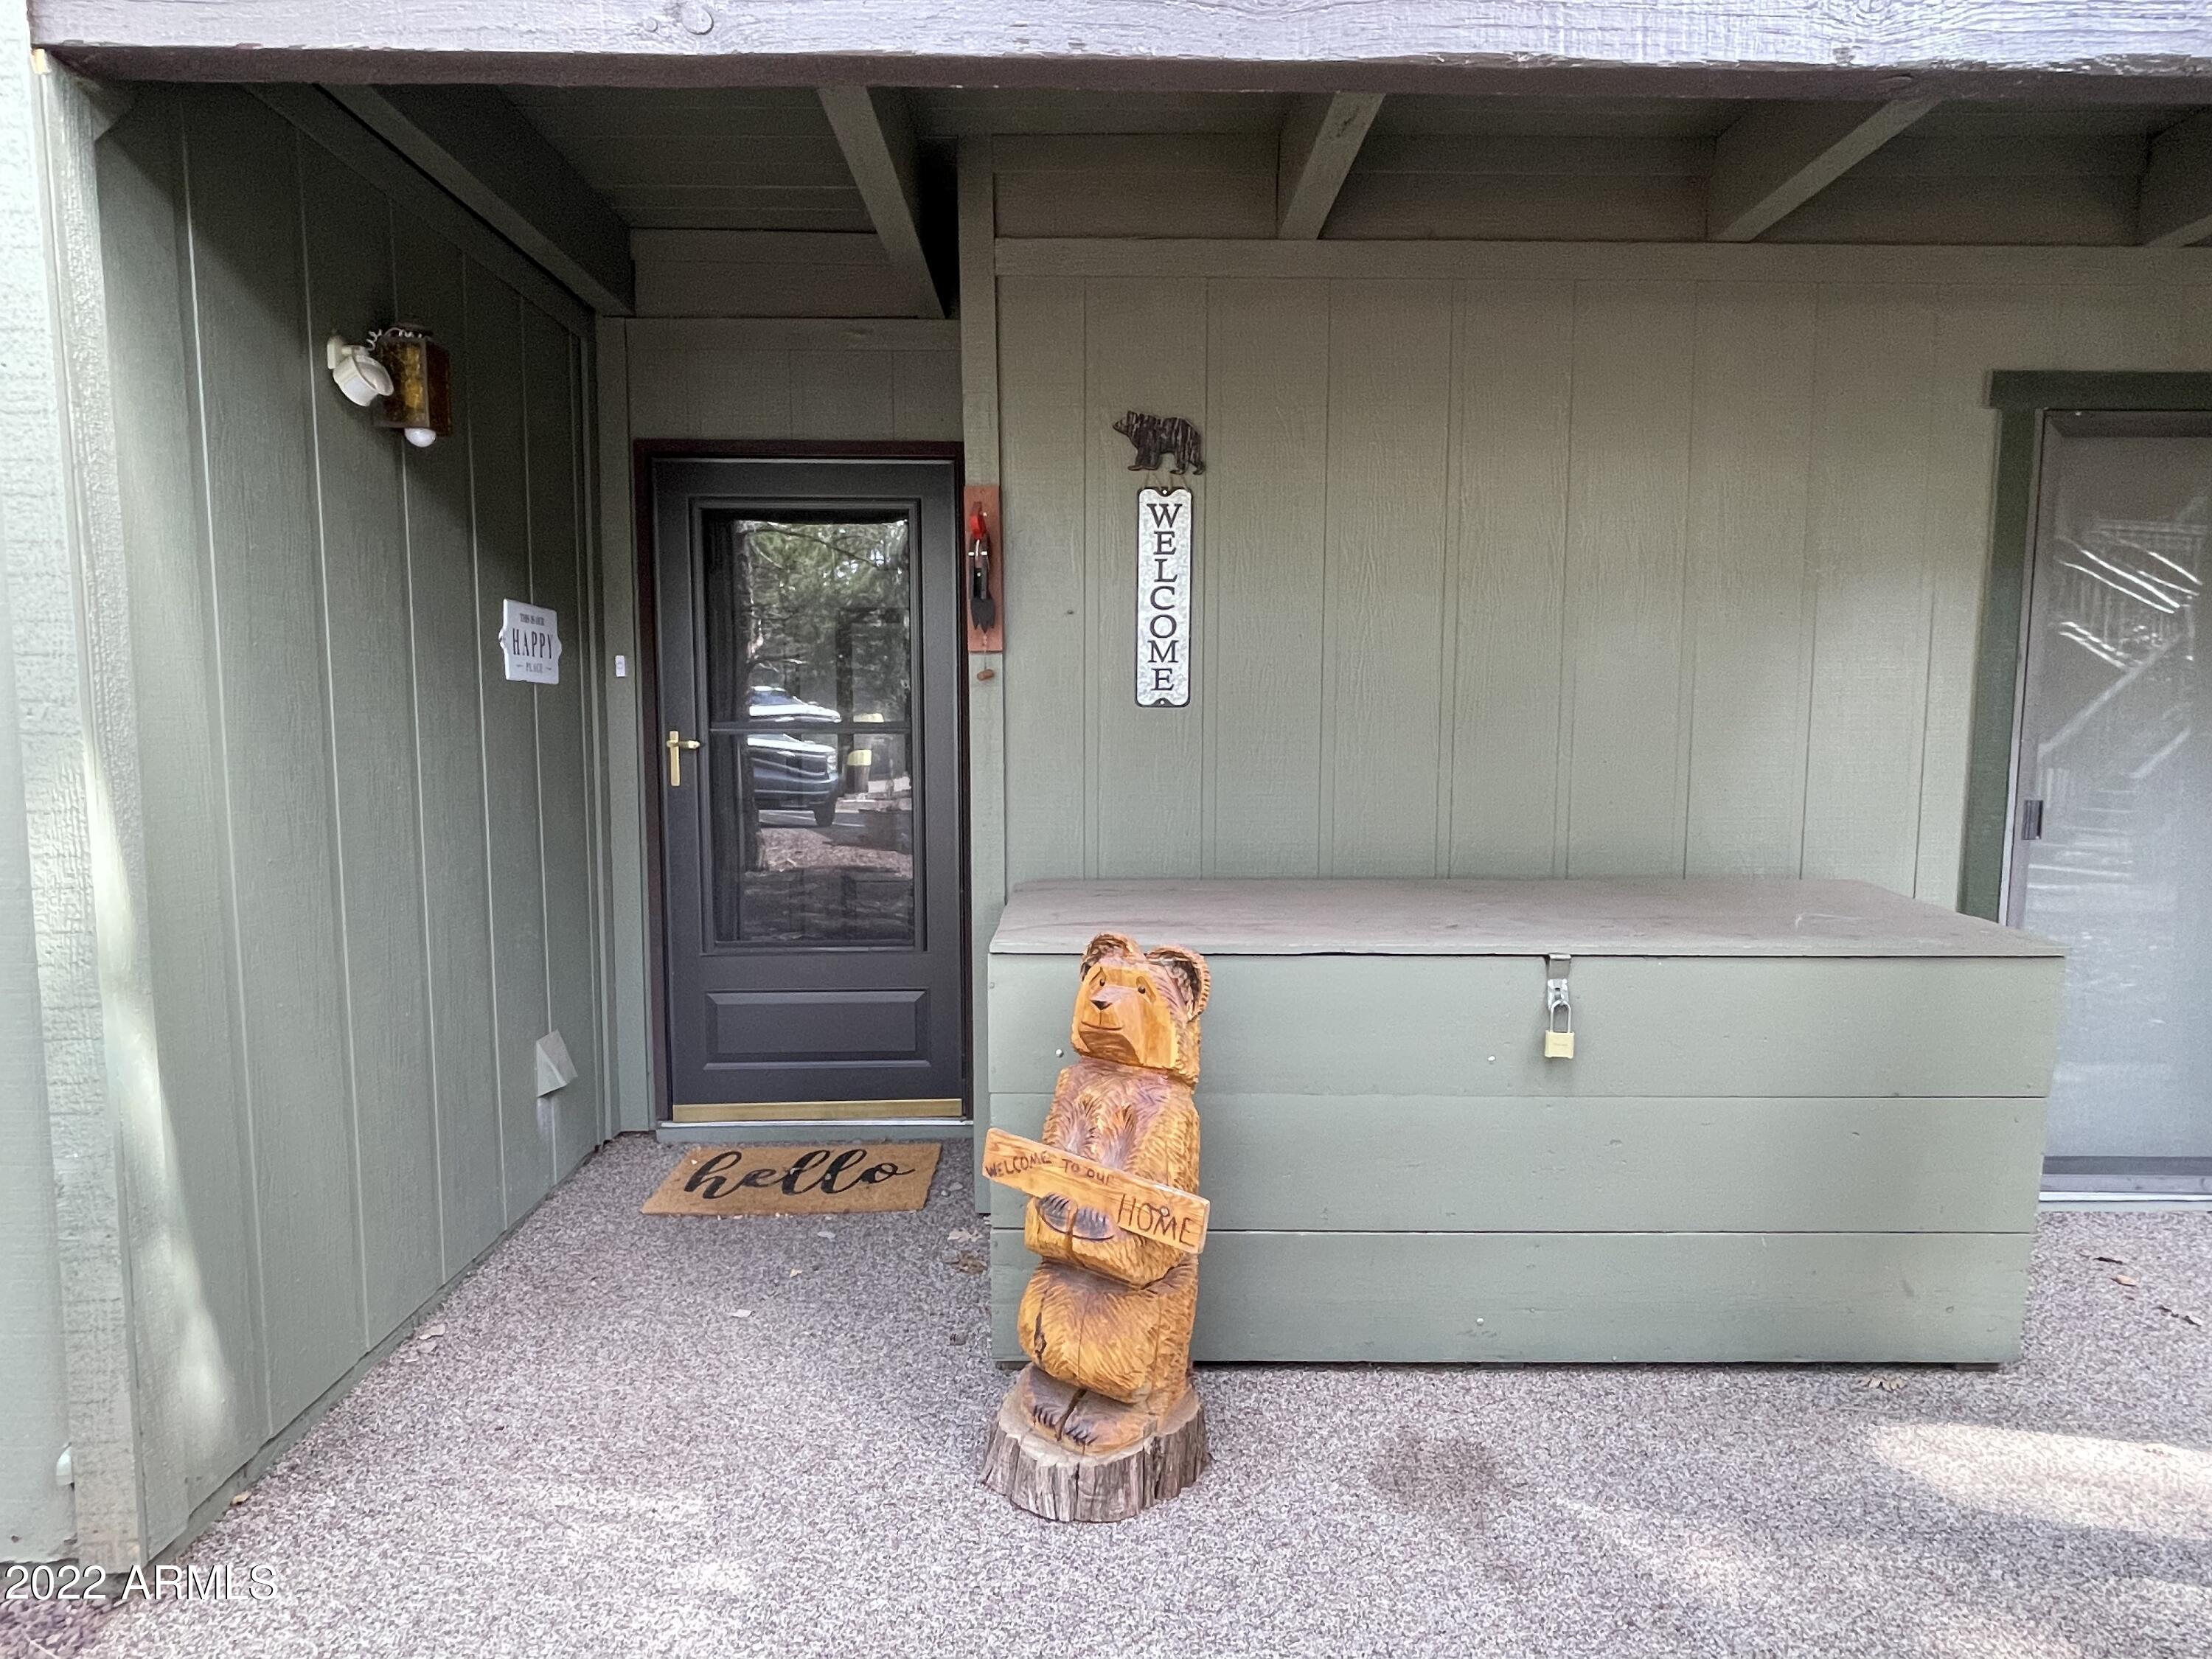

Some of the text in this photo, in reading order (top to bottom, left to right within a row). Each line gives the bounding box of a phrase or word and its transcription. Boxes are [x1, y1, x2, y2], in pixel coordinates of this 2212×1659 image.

[1147, 504, 1183, 691] WELCOME
[512, 628, 553, 659] HAPPY
[684, 1149, 915, 1200] hello
[985, 1150, 1051, 1178] WELCOME
[1117, 1193, 1196, 1248] HOME
